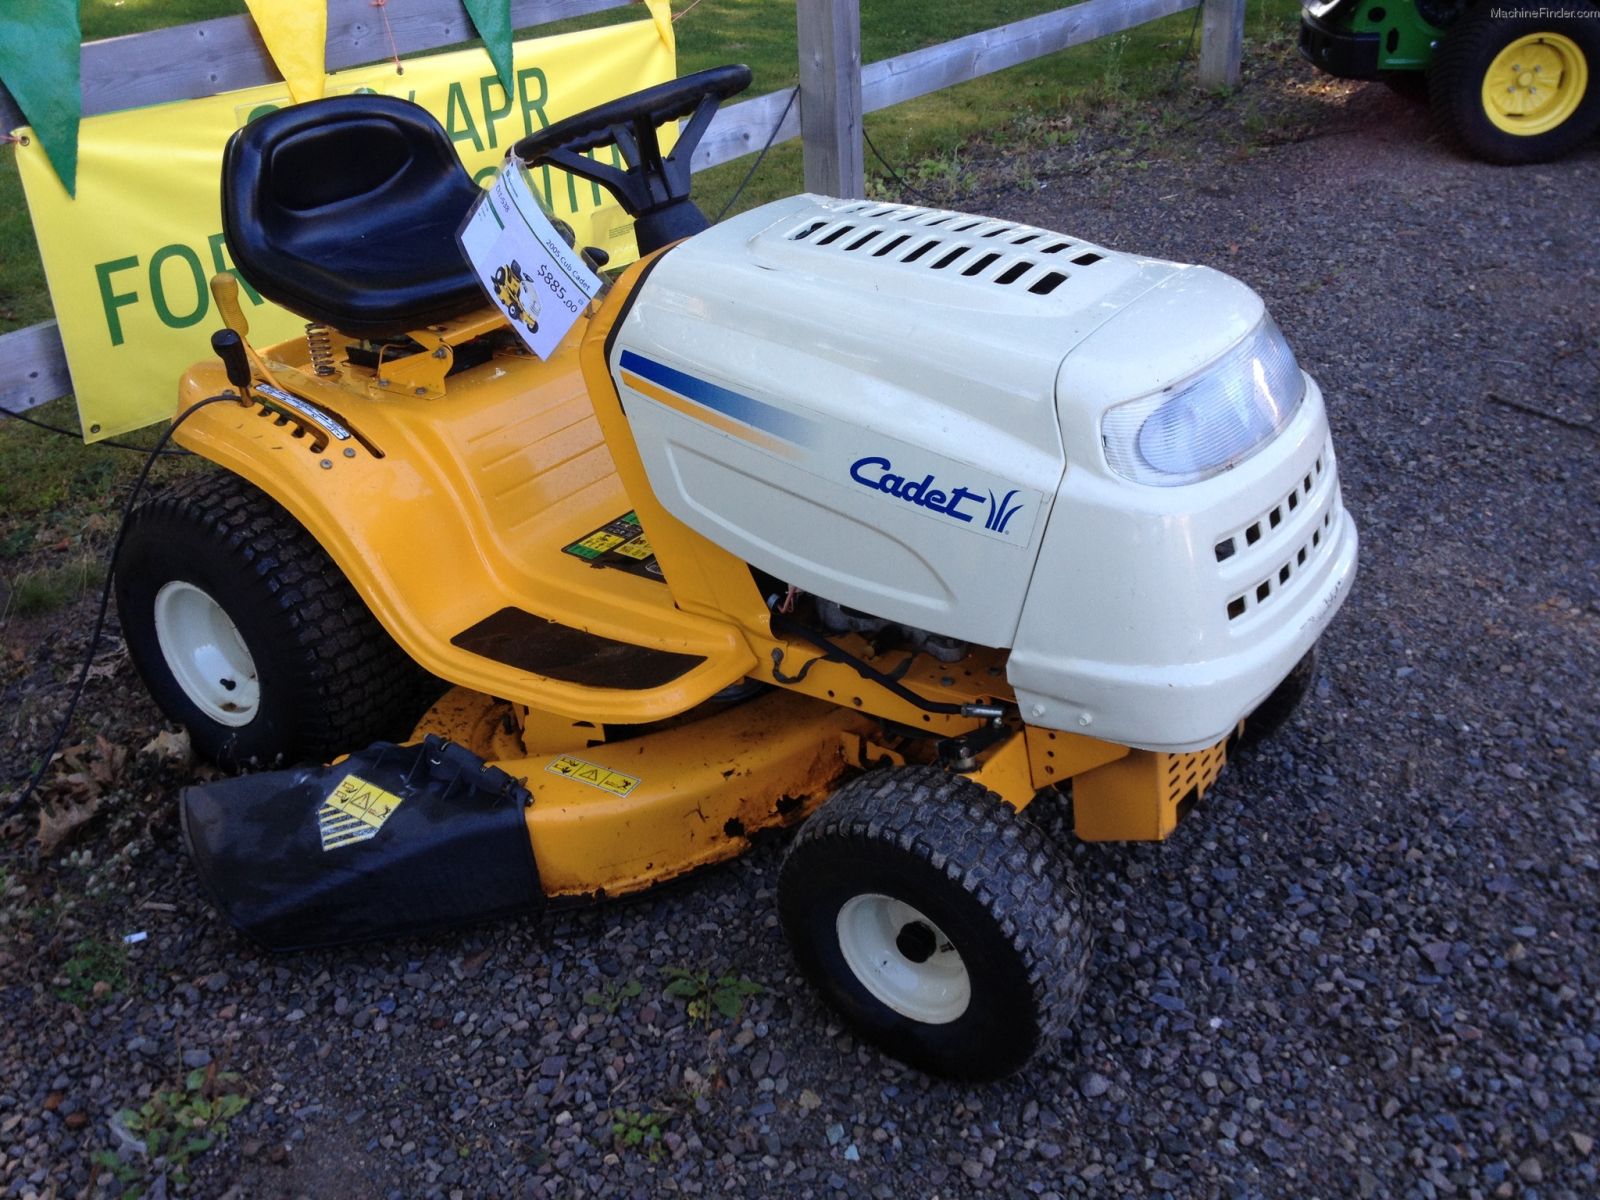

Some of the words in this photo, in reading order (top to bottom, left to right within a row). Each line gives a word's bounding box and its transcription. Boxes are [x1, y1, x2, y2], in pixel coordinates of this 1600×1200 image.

[446, 67, 550, 153] APR
[537, 264, 578, 313] $885.00
[545, 239, 561, 258] 2005
[560, 256, 572, 271] Cub
[572, 270, 591, 291] Cadet
[850, 456, 987, 523] Cadet
